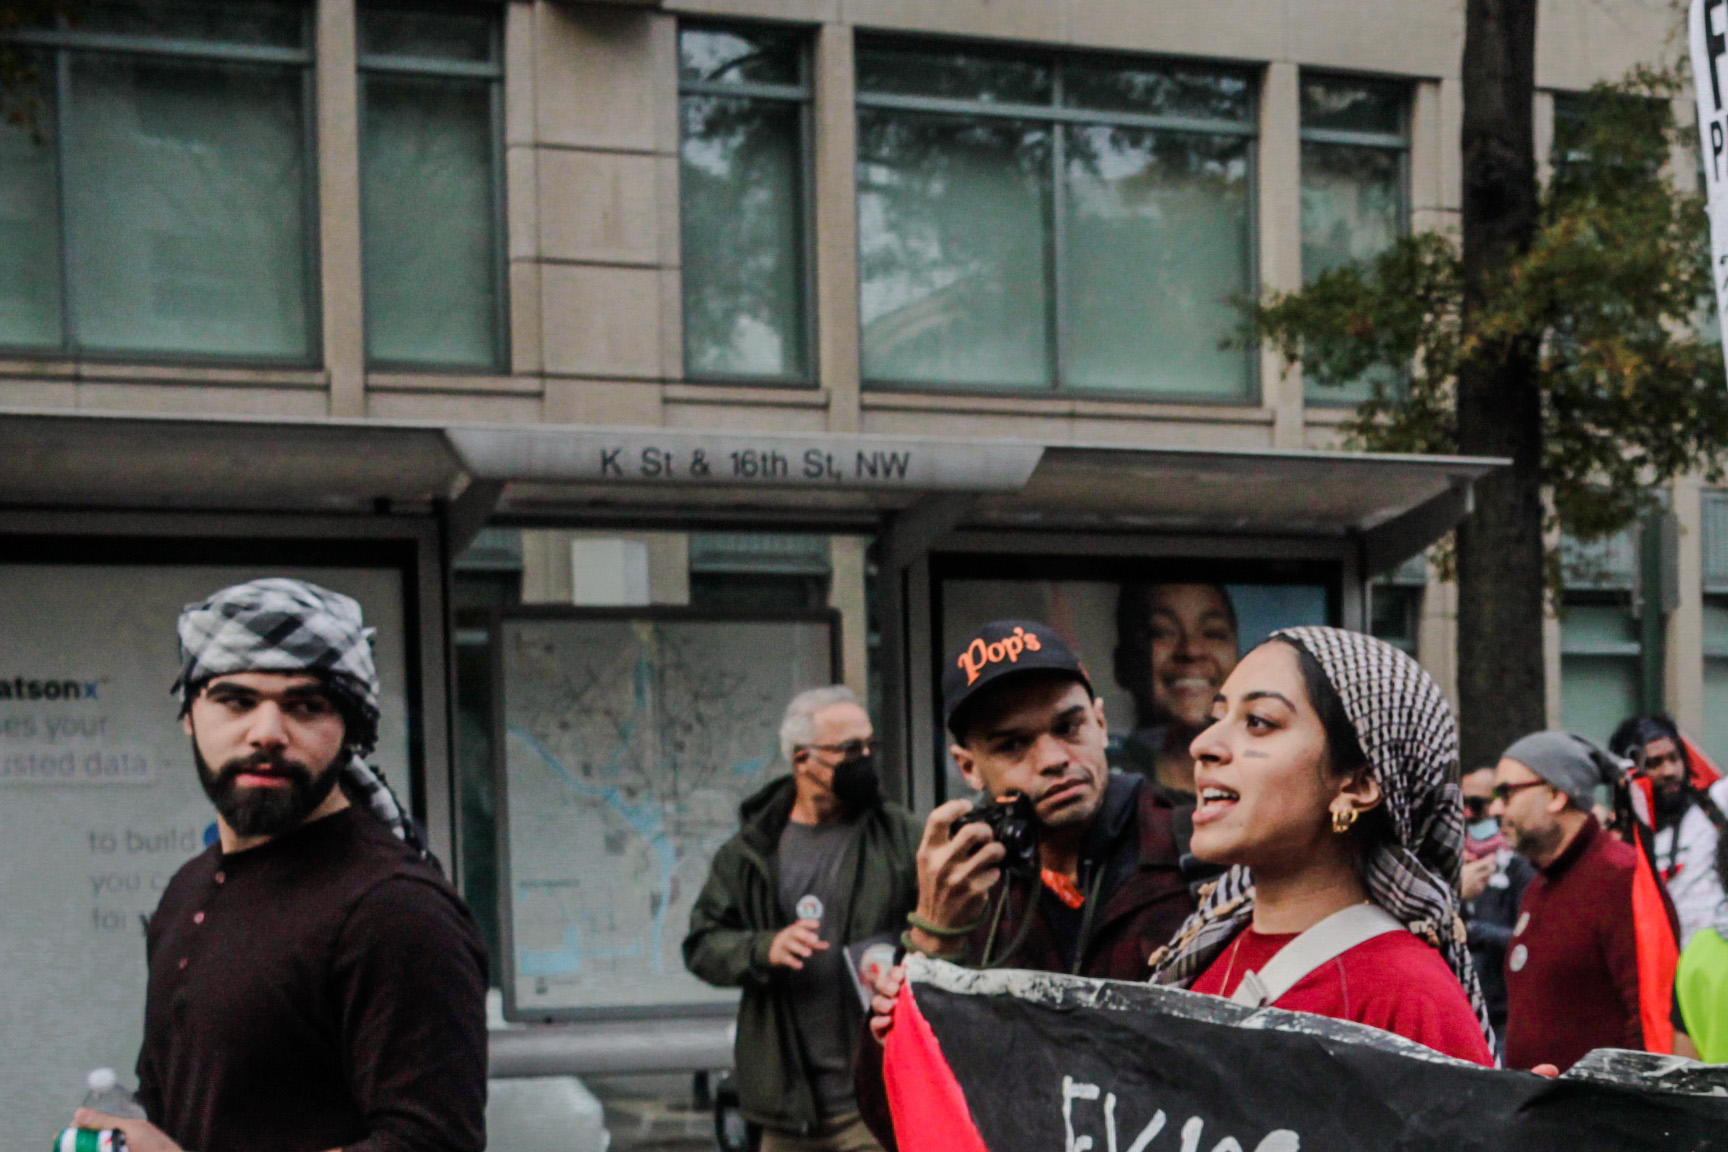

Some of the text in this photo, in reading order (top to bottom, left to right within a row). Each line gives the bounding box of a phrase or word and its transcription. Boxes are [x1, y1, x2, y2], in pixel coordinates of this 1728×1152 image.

[600, 448, 624, 477] K
[640, 447, 673, 477] St
[689, 448, 711, 477] &
[731, 448, 789, 478] 16th
[855, 450, 910, 478] NW
[957, 627, 1041, 686] Pop's
[84, 753, 148, 776] data
